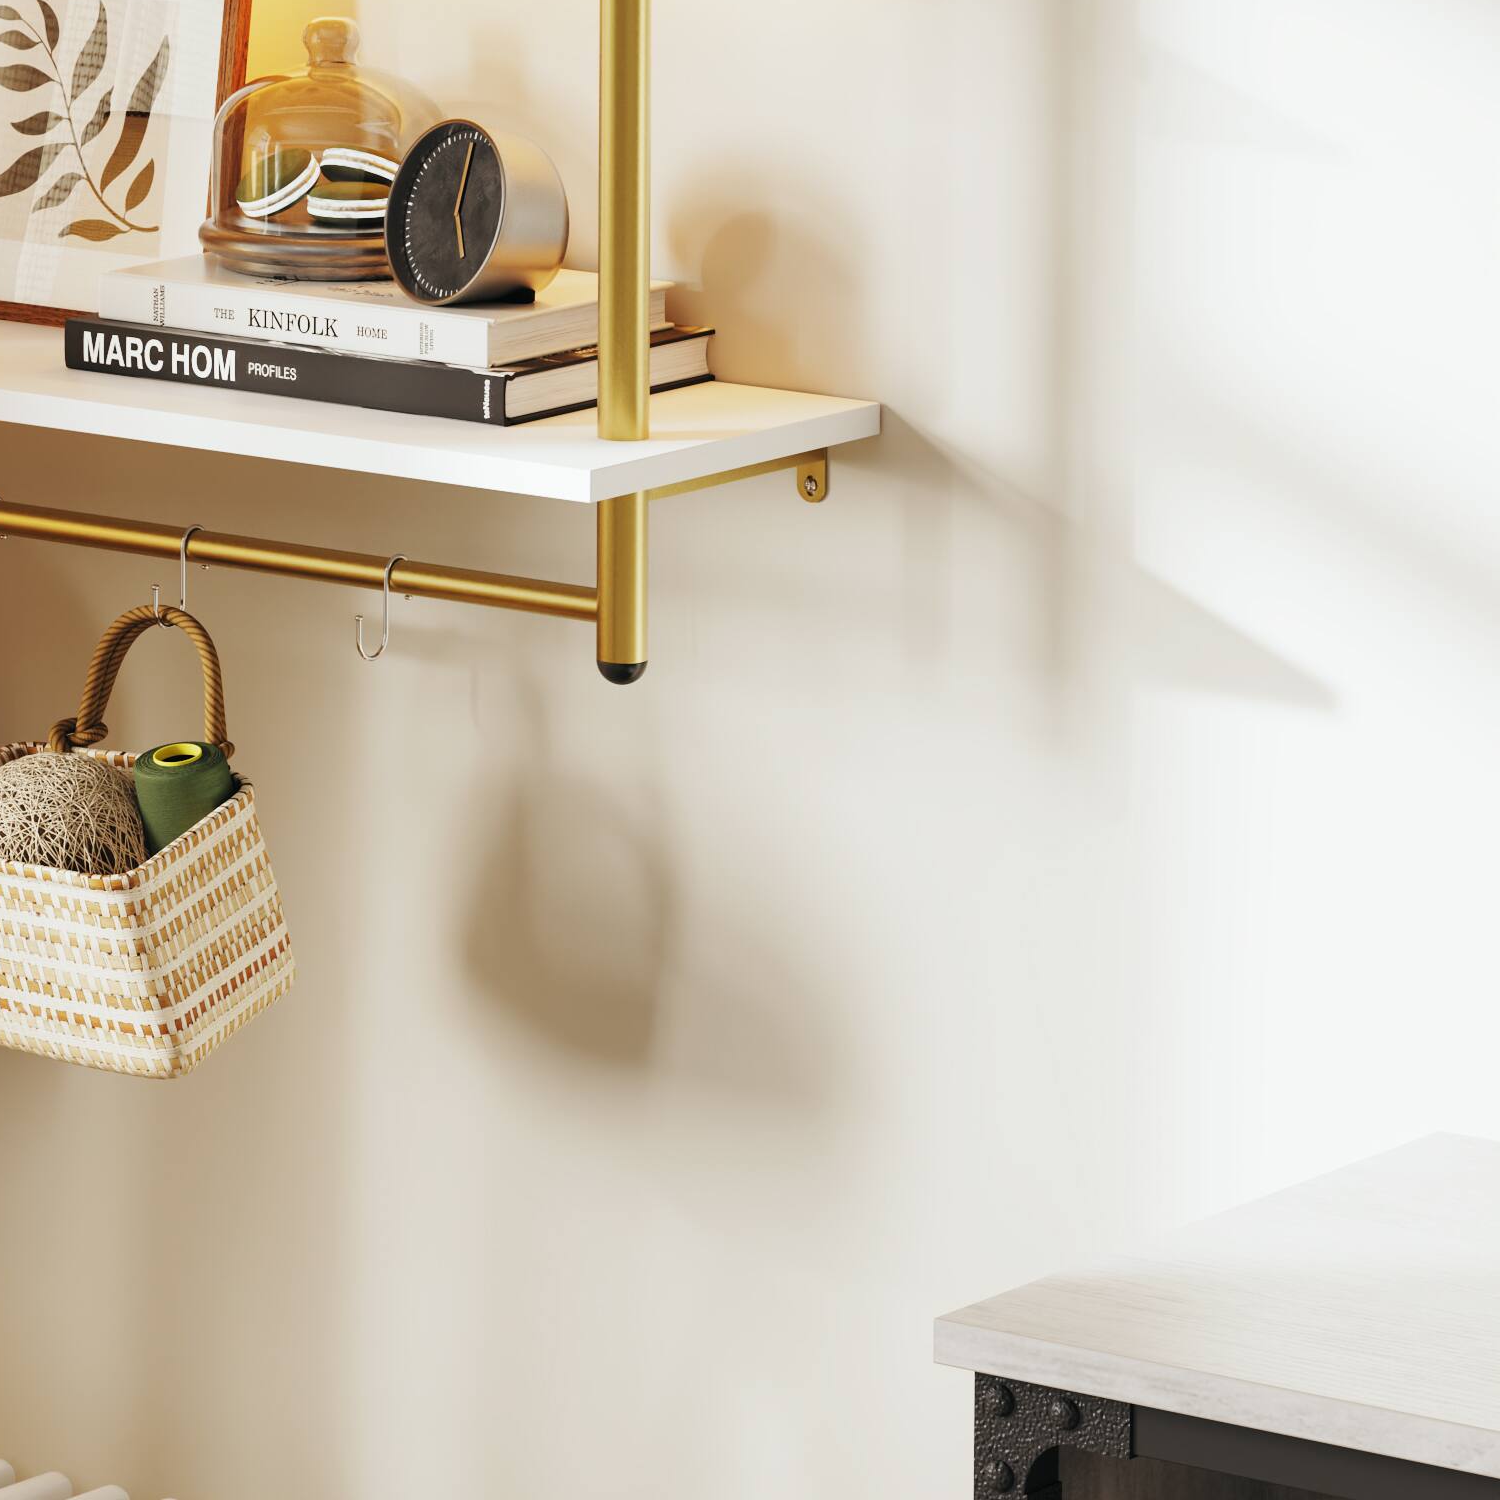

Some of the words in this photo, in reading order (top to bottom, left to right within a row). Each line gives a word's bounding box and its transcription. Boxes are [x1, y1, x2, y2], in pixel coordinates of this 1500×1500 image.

[213, 308, 236, 321] THE
[247, 307, 339, 339] KINFOLK
[357, 326, 388, 340] HOME
[82, 330, 164, 373] MARC
[171, 340, 237, 382] HOM
[247, 361, 297, 382] PROFILES
